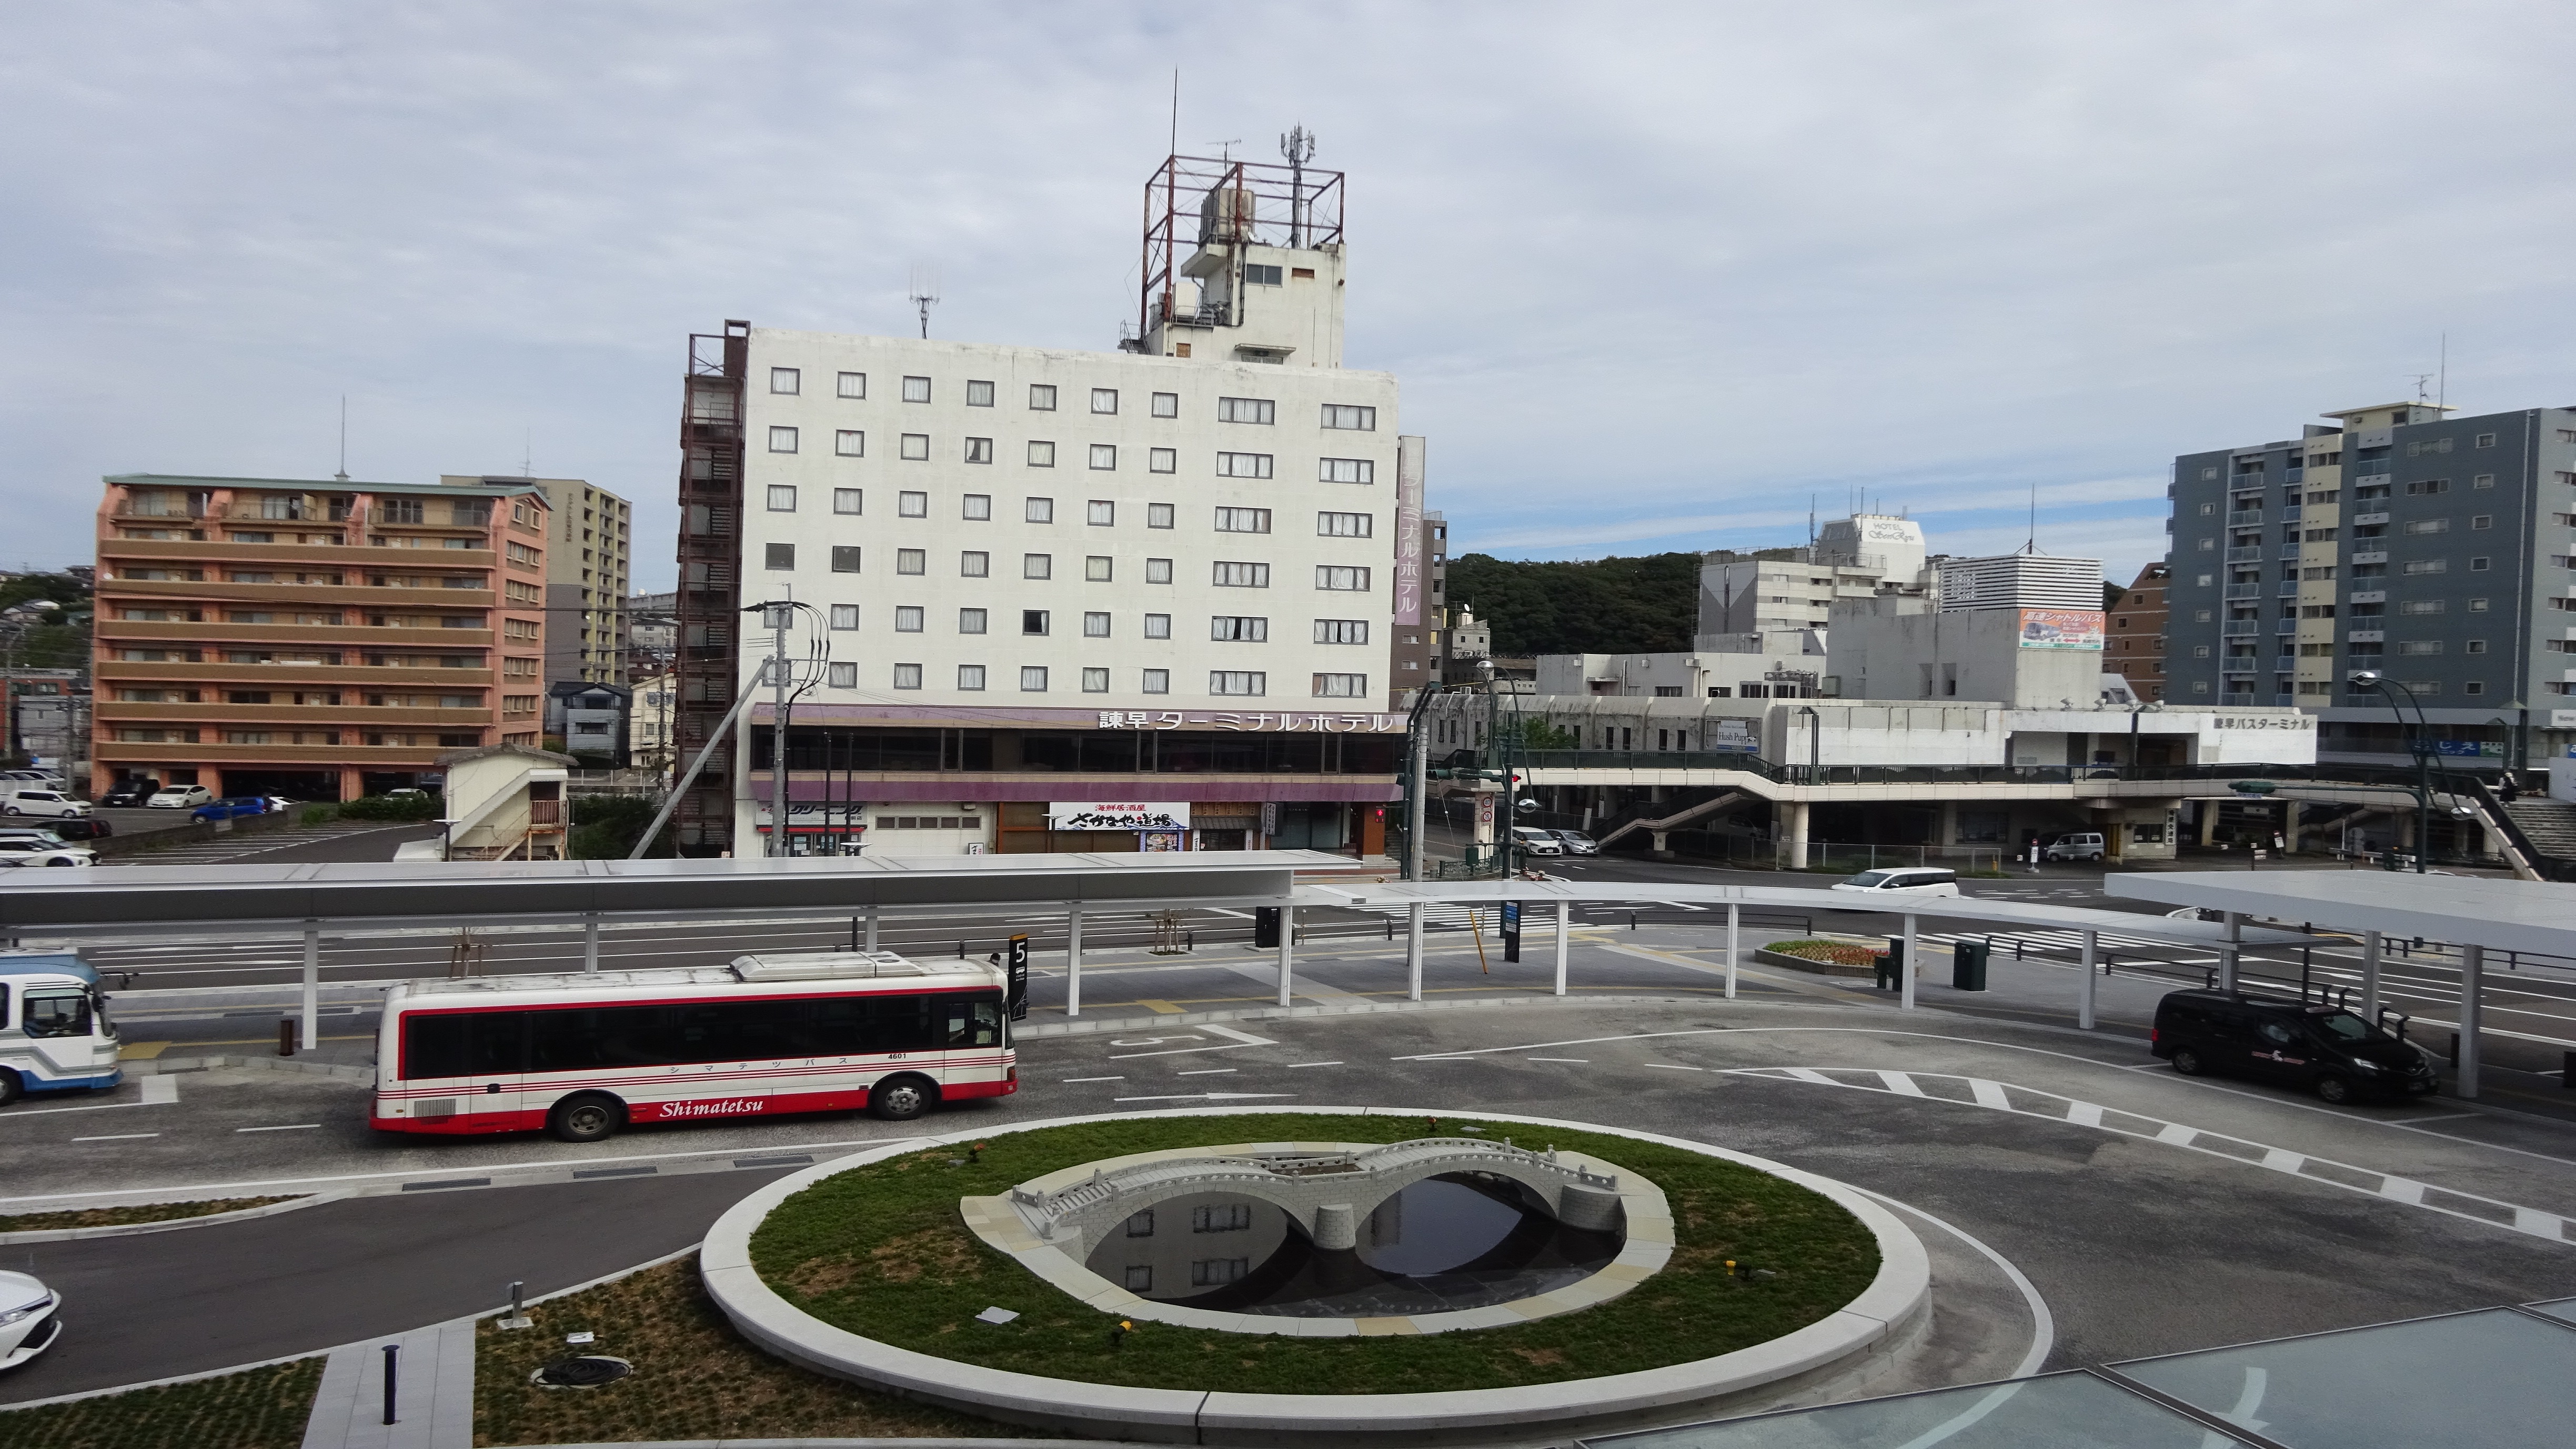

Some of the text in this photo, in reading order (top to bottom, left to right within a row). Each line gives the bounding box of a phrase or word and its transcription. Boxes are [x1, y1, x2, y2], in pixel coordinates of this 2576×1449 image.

[1873, 522, 1903, 531] HOTEL
[2022, 611, 2103, 623] 高速シャトルバス
[1718, 731, 1733, 741] Hush
[789, 805, 863, 815] クリーニング
[1067, 812, 1172, 828] さかなや道場
[1016, 941, 1025, 963] 5
[659, 1098, 763, 1118] Shimatetsu
